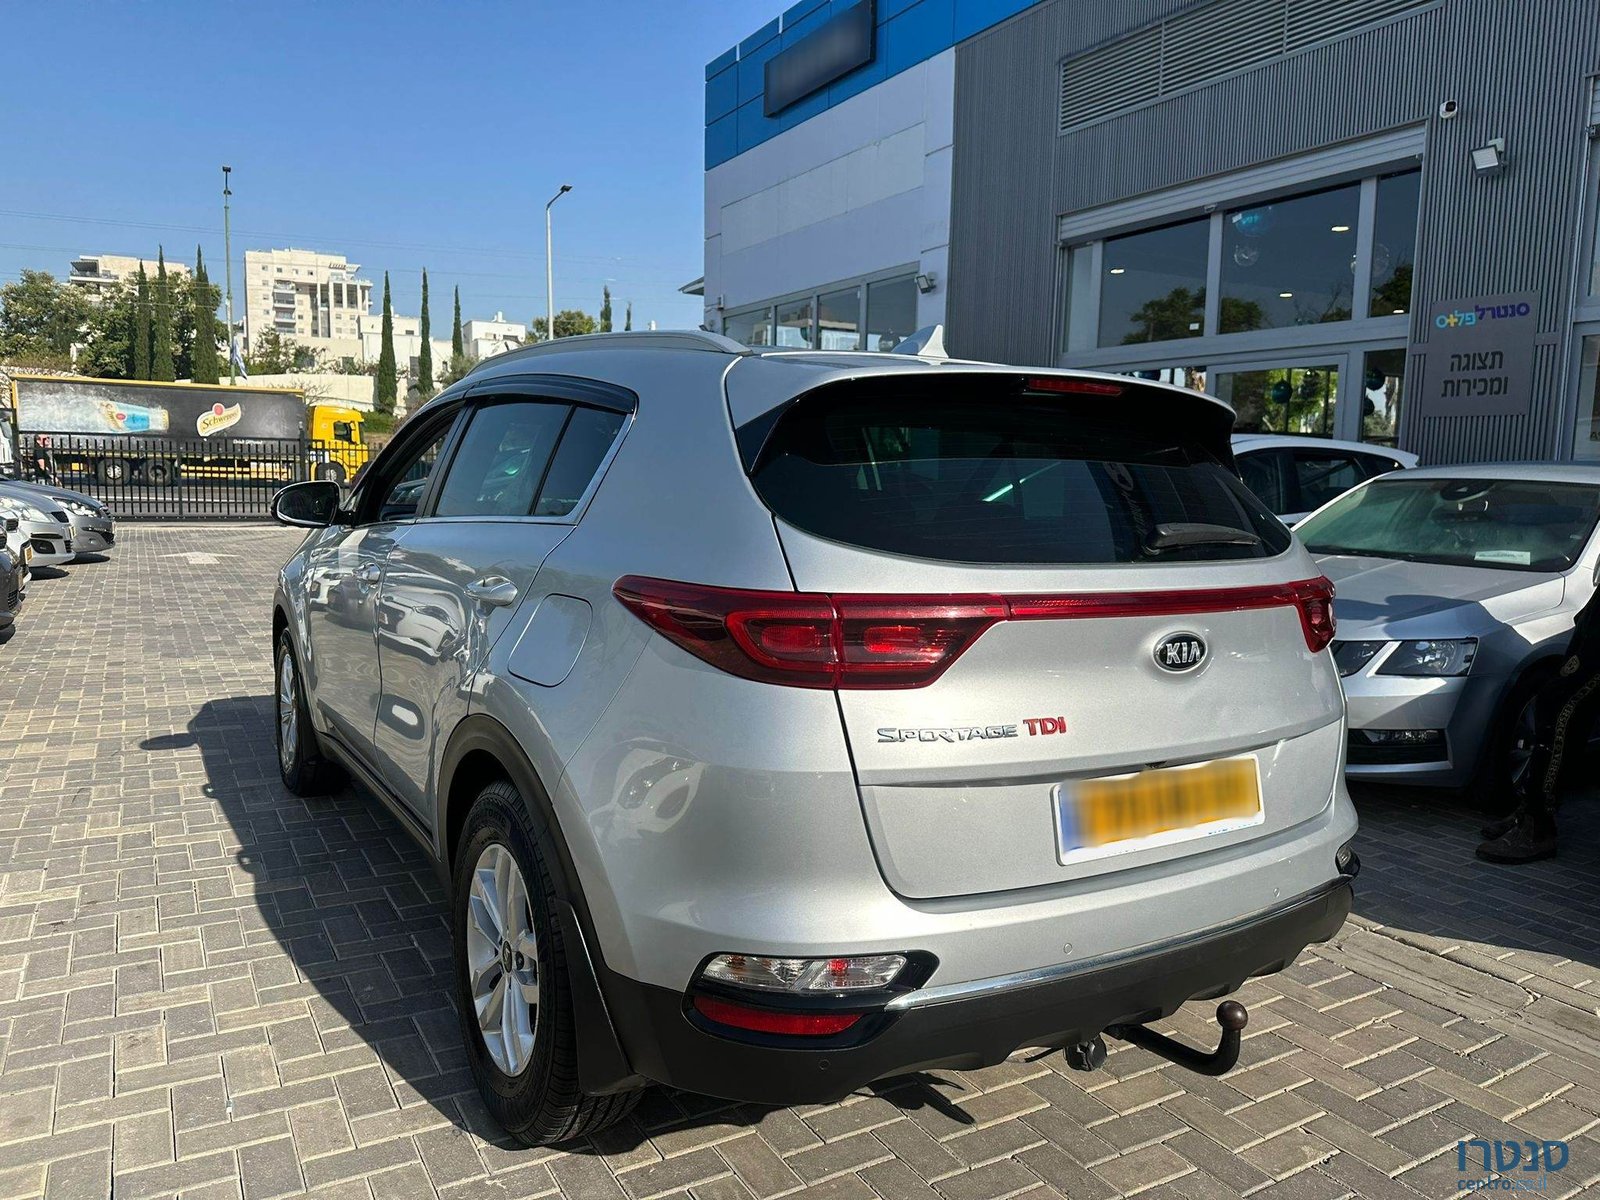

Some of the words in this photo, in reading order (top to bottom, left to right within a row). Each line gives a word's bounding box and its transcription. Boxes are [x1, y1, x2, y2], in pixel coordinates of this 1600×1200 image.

[1475, 302, 1530, 320] סנטרל
[1450, 351, 1504, 372] תצוגה
[1441, 376, 1508, 397] ומכירות
[1166, 641, 1200, 664] KIA
[877, 725, 1018, 743] SPORTAGE
[1023, 716, 1067, 736] TDI
